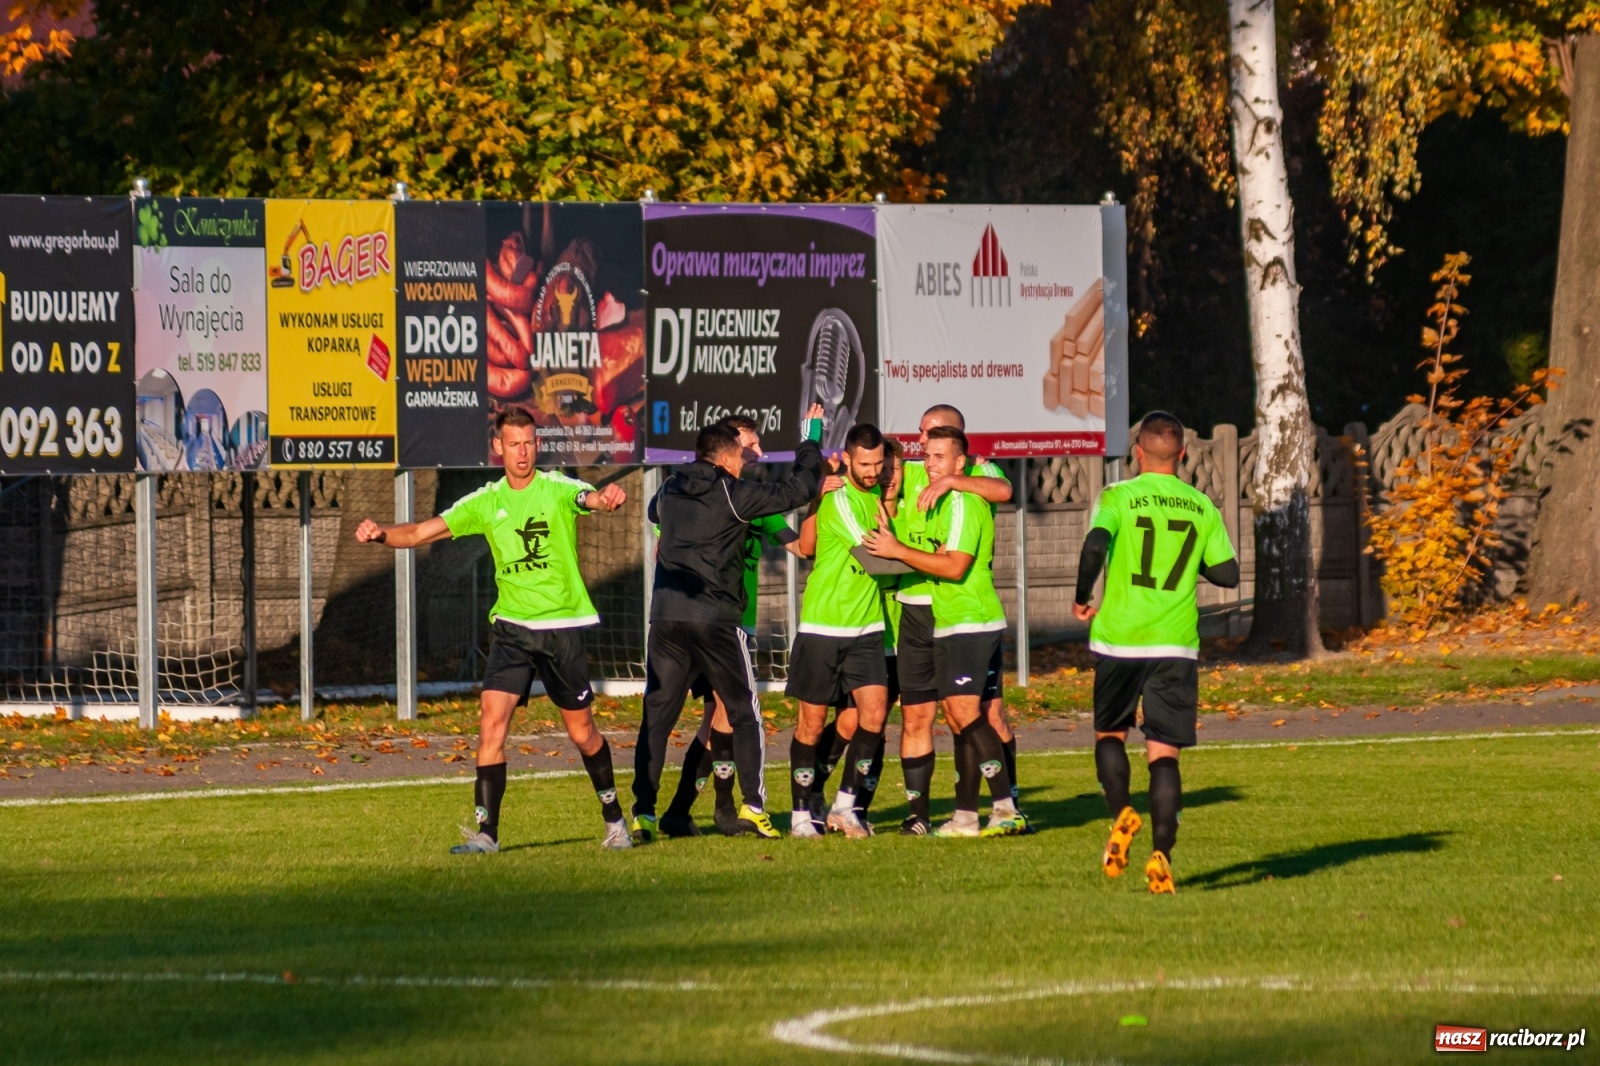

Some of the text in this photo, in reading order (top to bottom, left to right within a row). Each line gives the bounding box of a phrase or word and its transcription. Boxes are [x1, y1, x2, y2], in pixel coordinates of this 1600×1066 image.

[9, 229, 119, 255] www.gregorbau.pl
[299, 231, 390, 291] BAGER
[404, 261, 477, 277] WIEPRZOWINA
[652, 241, 865, 287] Oprawa muzyczna imprez
[1020, 263, 1038, 277] Polska
[170, 265, 231, 293] Sala do
[404, 282, 478, 302] WOŁOWINA
[915, 262, 962, 296] ABIES
[1020, 283, 1074, 301] Dystrybucja Drewna
[10, 291, 119, 322] BUDUJEMY
[158, 303, 244, 338] Wynajęcia
[279, 312, 384, 328] WYKONAM USŁUGI
[405, 304, 478, 354] DRÓB
[695, 308, 780, 338] EUGENIUSZ
[11, 341, 121, 373] OD A DO Z
[307, 337, 361, 357] KOPARKĄ
[530, 331, 602, 368] JANETA
[652, 307, 692, 384] DJ
[178, 353, 261, 372] tel. 519 847 833
[405, 359, 478, 388] WĘDLINY
[693, 345, 777, 377] MIKOŁAJEK
[885, 360, 1024, 383] Twój specjalista od drewna
[312, 382, 353, 397] USŁUGI
[405, 387, 479, 408] GARMAŻERKA
[289, 406, 376, 421] TRANSPORTOWE
[680, 401, 700, 431] tel.
[761, 405, 781, 434] 761
[0, 406, 123, 458] 092 363
[299, 440, 384, 459] 880 557 965
[1129, 495, 1204, 516] LKS TWORKÓW
[1131, 515, 1198, 591] 17
